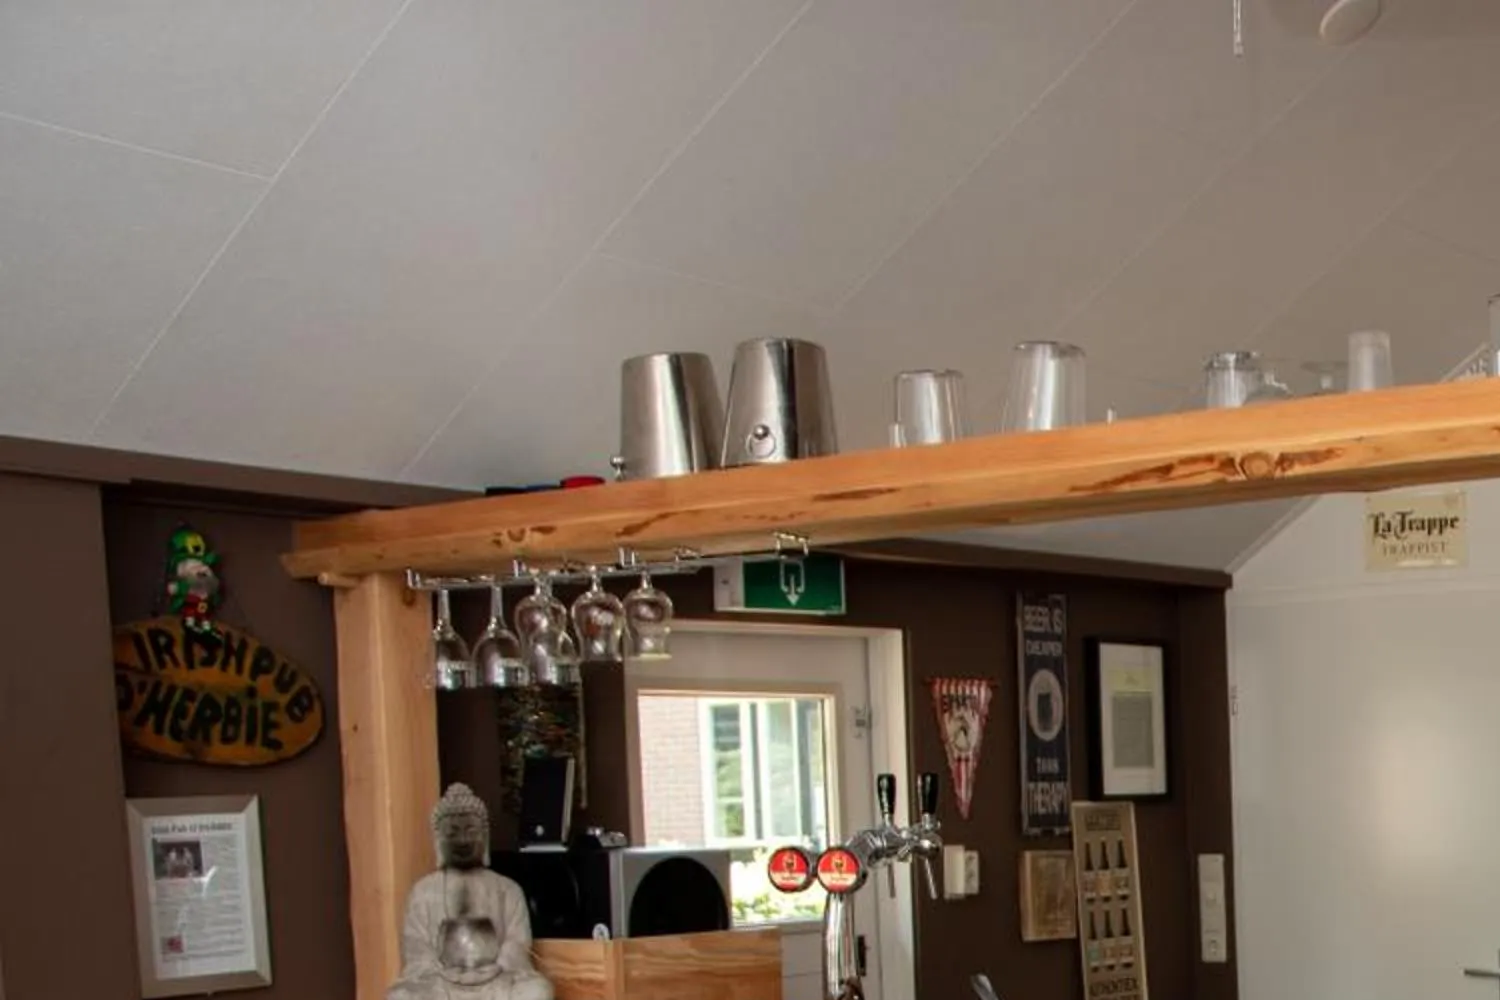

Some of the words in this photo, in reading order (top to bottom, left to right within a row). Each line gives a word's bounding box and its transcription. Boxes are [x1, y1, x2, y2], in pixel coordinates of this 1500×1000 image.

[1367, 512, 1392, 541] La
[1393, 509, 1460, 541] Trappe
[253, 646, 315, 724] PUB
